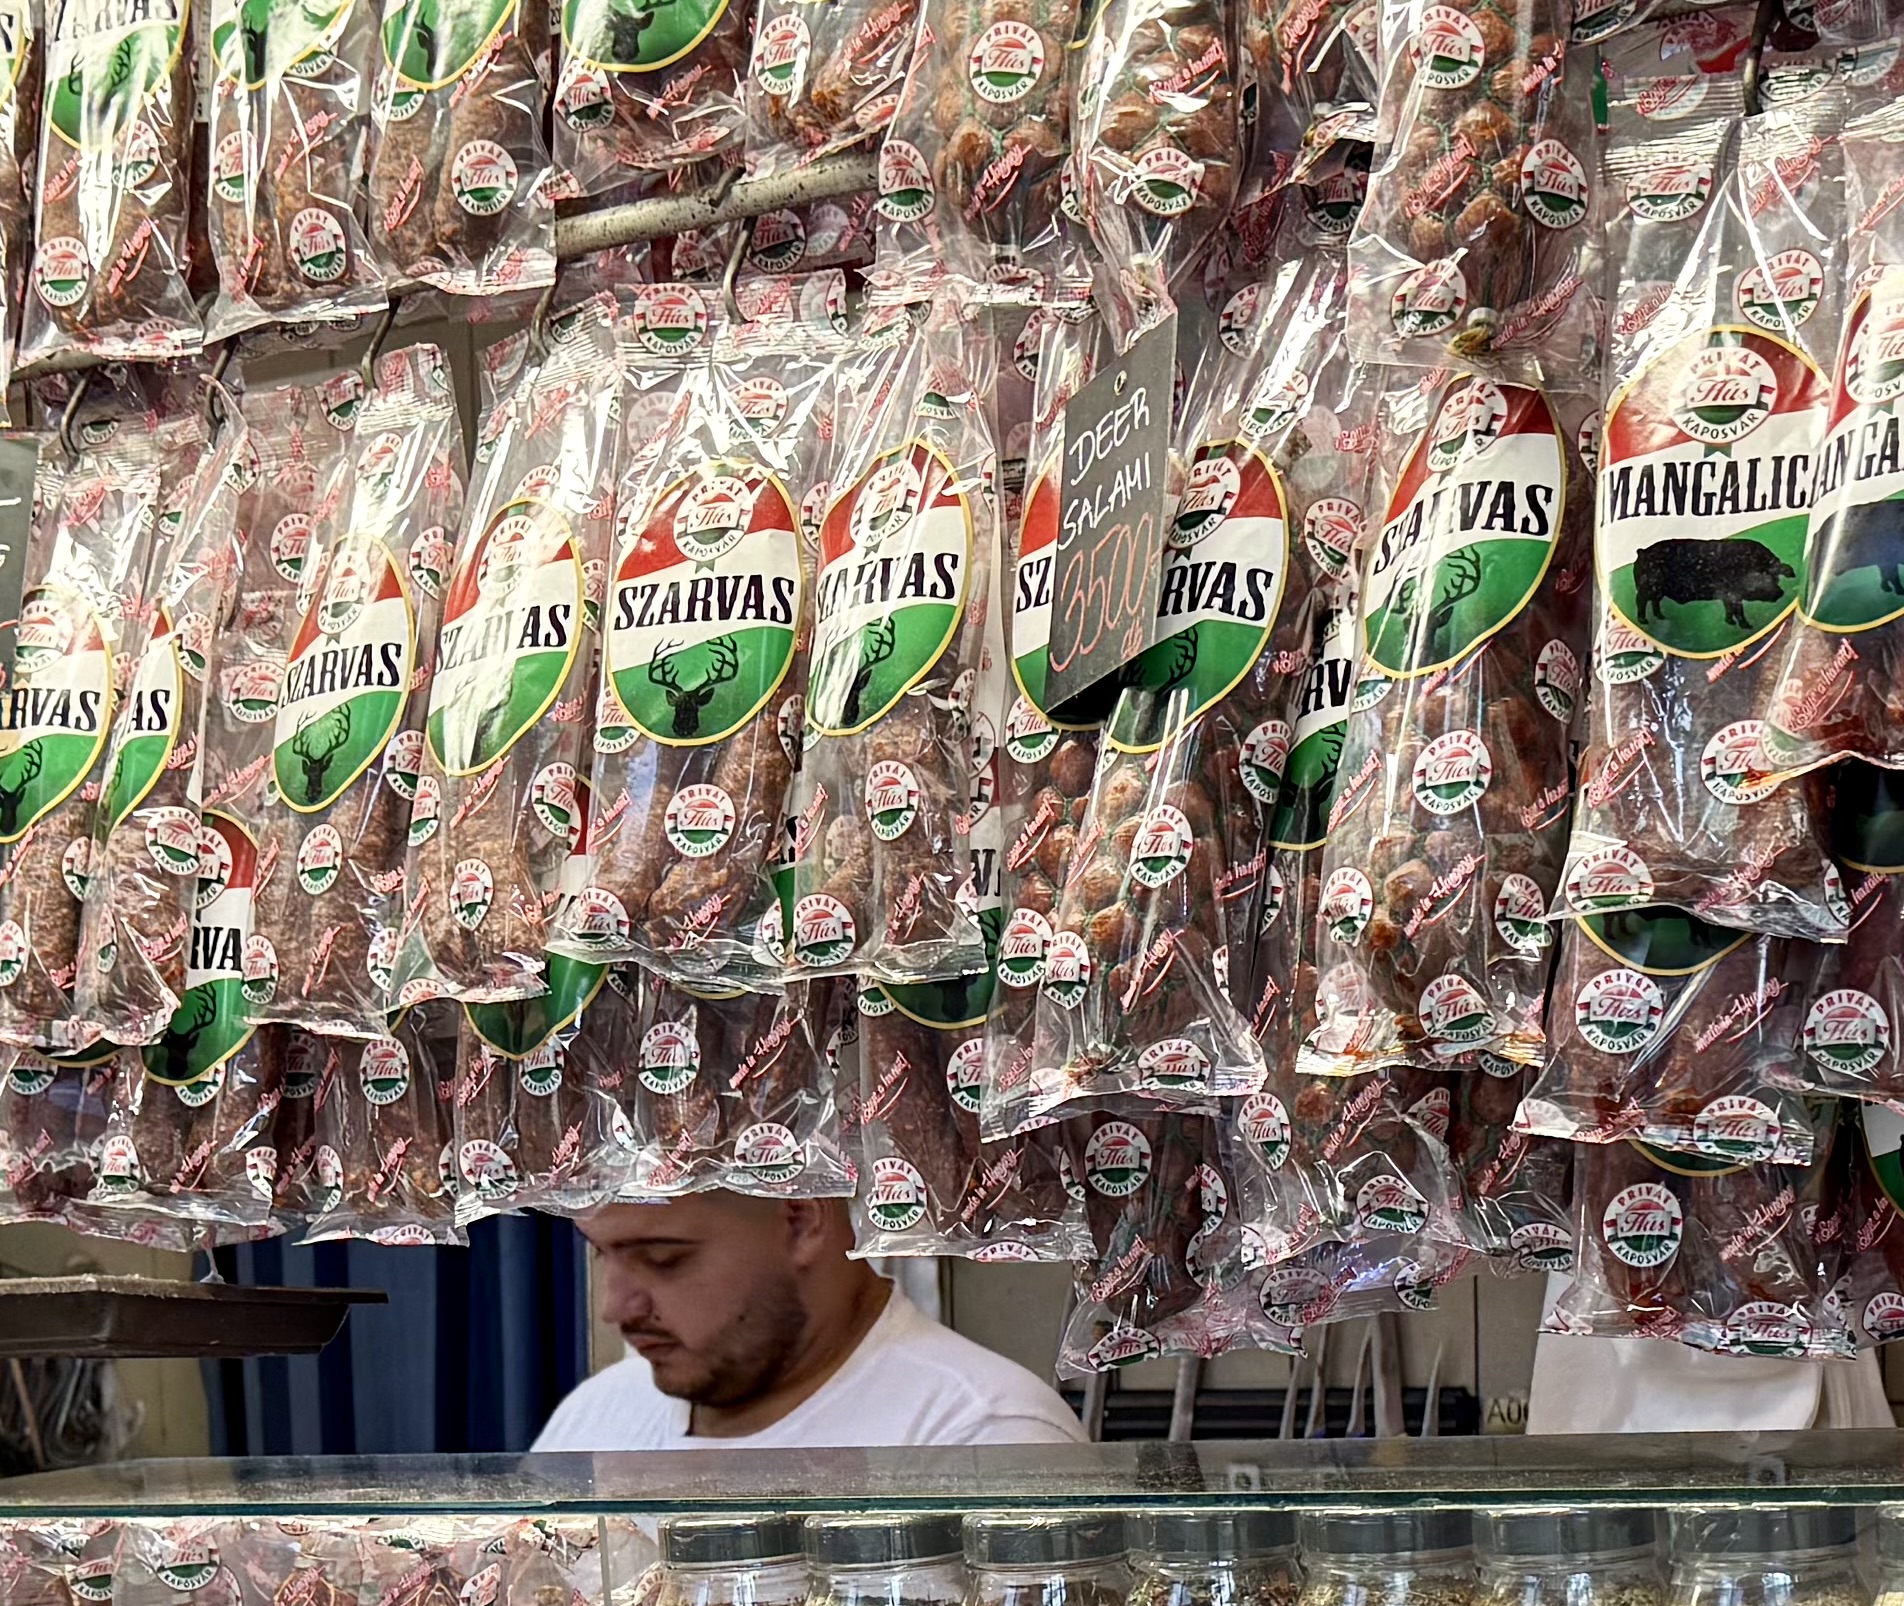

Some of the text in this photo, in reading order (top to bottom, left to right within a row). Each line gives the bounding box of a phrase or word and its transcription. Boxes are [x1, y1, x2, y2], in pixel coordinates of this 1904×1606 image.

[1069, 386, 1150, 487] DEER
[1681, 412, 1761, 440] KAPOSVÁR
[1057, 453, 1152, 550] SALAMI
[1600, 450, 1818, 528] MANGALIC
[614, 574, 795, 630] SZARVAS
